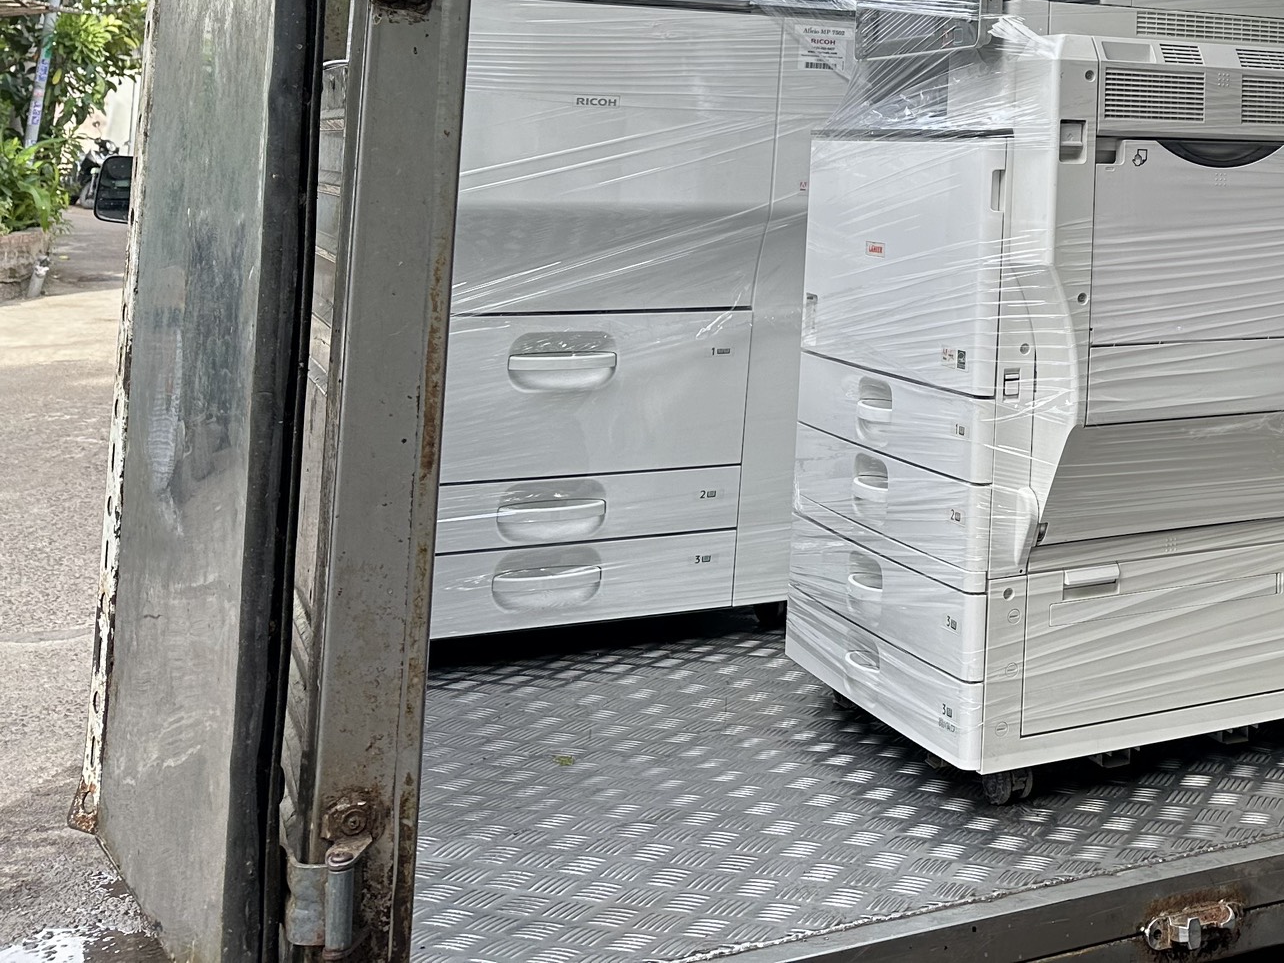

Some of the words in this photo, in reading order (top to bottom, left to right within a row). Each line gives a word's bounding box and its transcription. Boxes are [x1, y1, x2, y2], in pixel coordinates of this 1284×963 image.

[576, 96, 618, 108] RICOH
[711, 348, 716, 356] 1
[700, 490, 706, 498] 2
[950, 509, 956, 520] 2
[694, 555, 700, 564] 3
[946, 616, 952, 628] 3
[942, 704, 948, 715] 3
